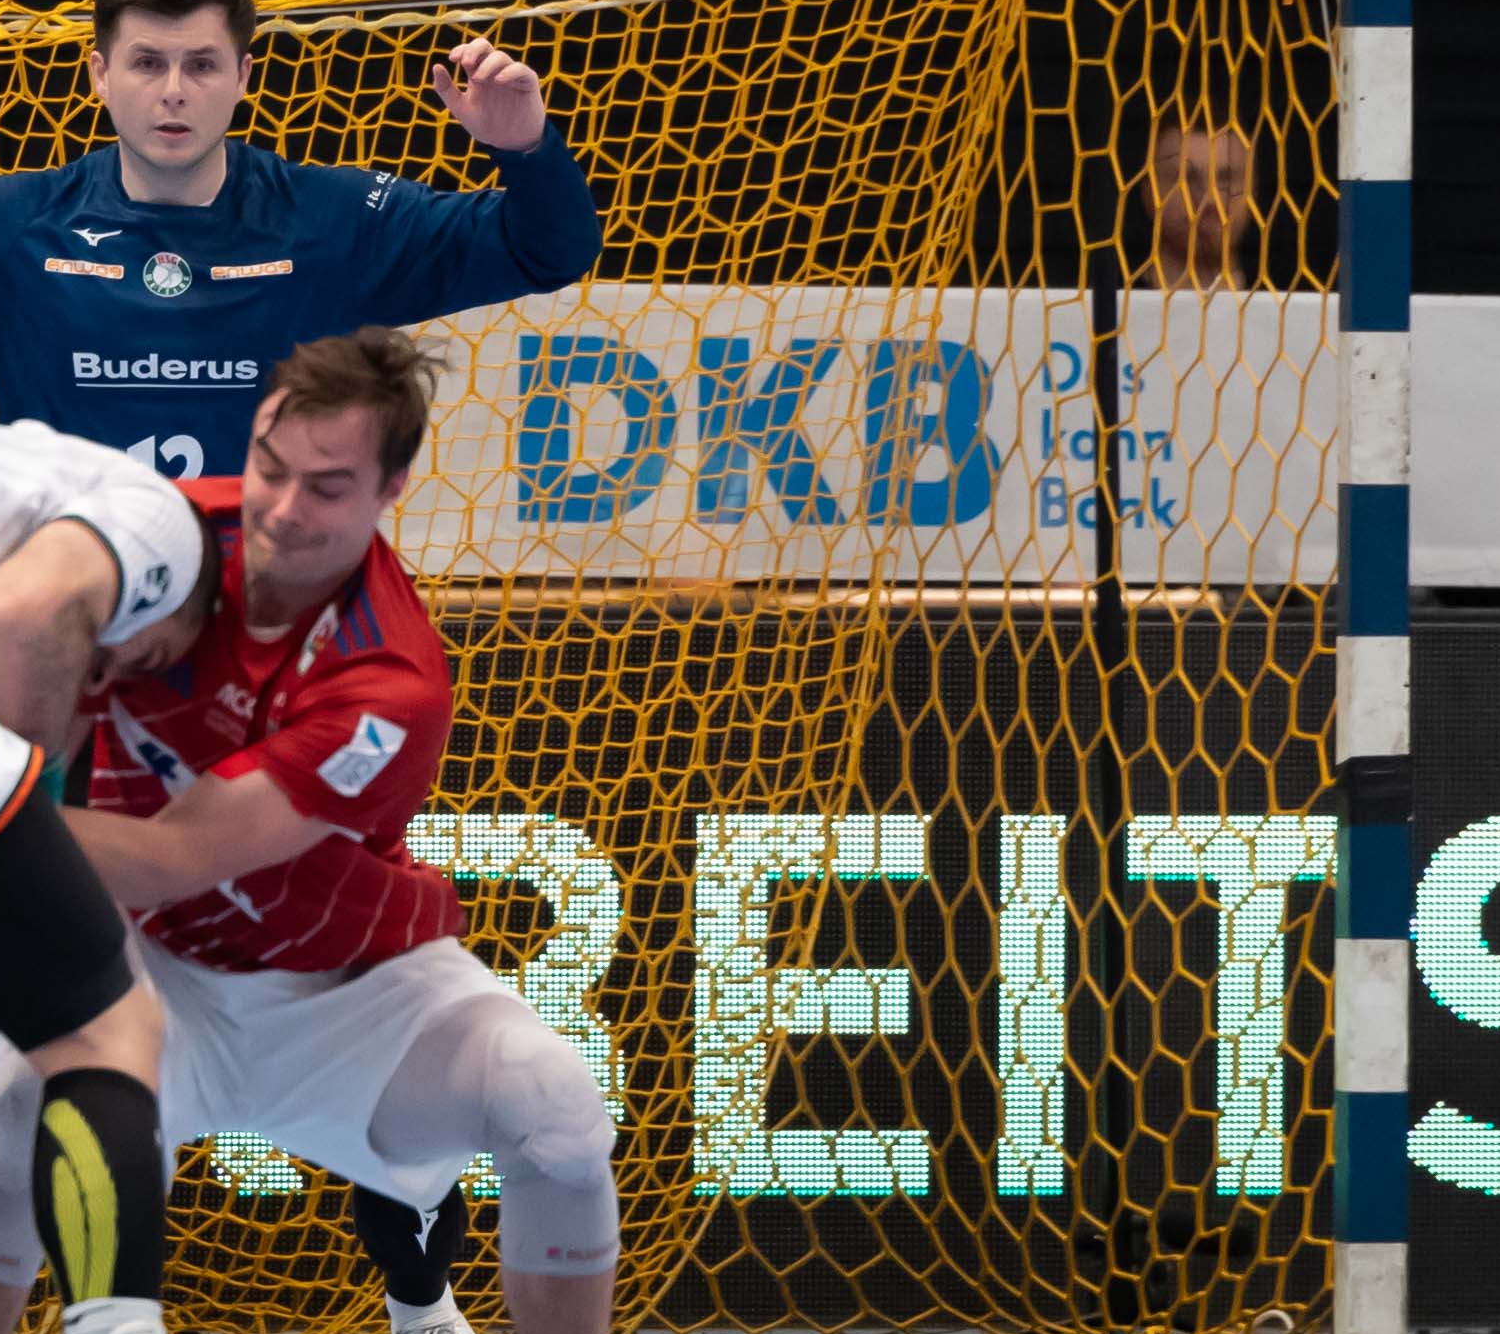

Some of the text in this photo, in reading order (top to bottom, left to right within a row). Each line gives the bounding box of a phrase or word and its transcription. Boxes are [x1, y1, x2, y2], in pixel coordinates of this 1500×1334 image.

[72, 351, 259, 380] Buderus
[1042, 341, 1145, 394] Ds
[518, 335, 1001, 527] DKB
